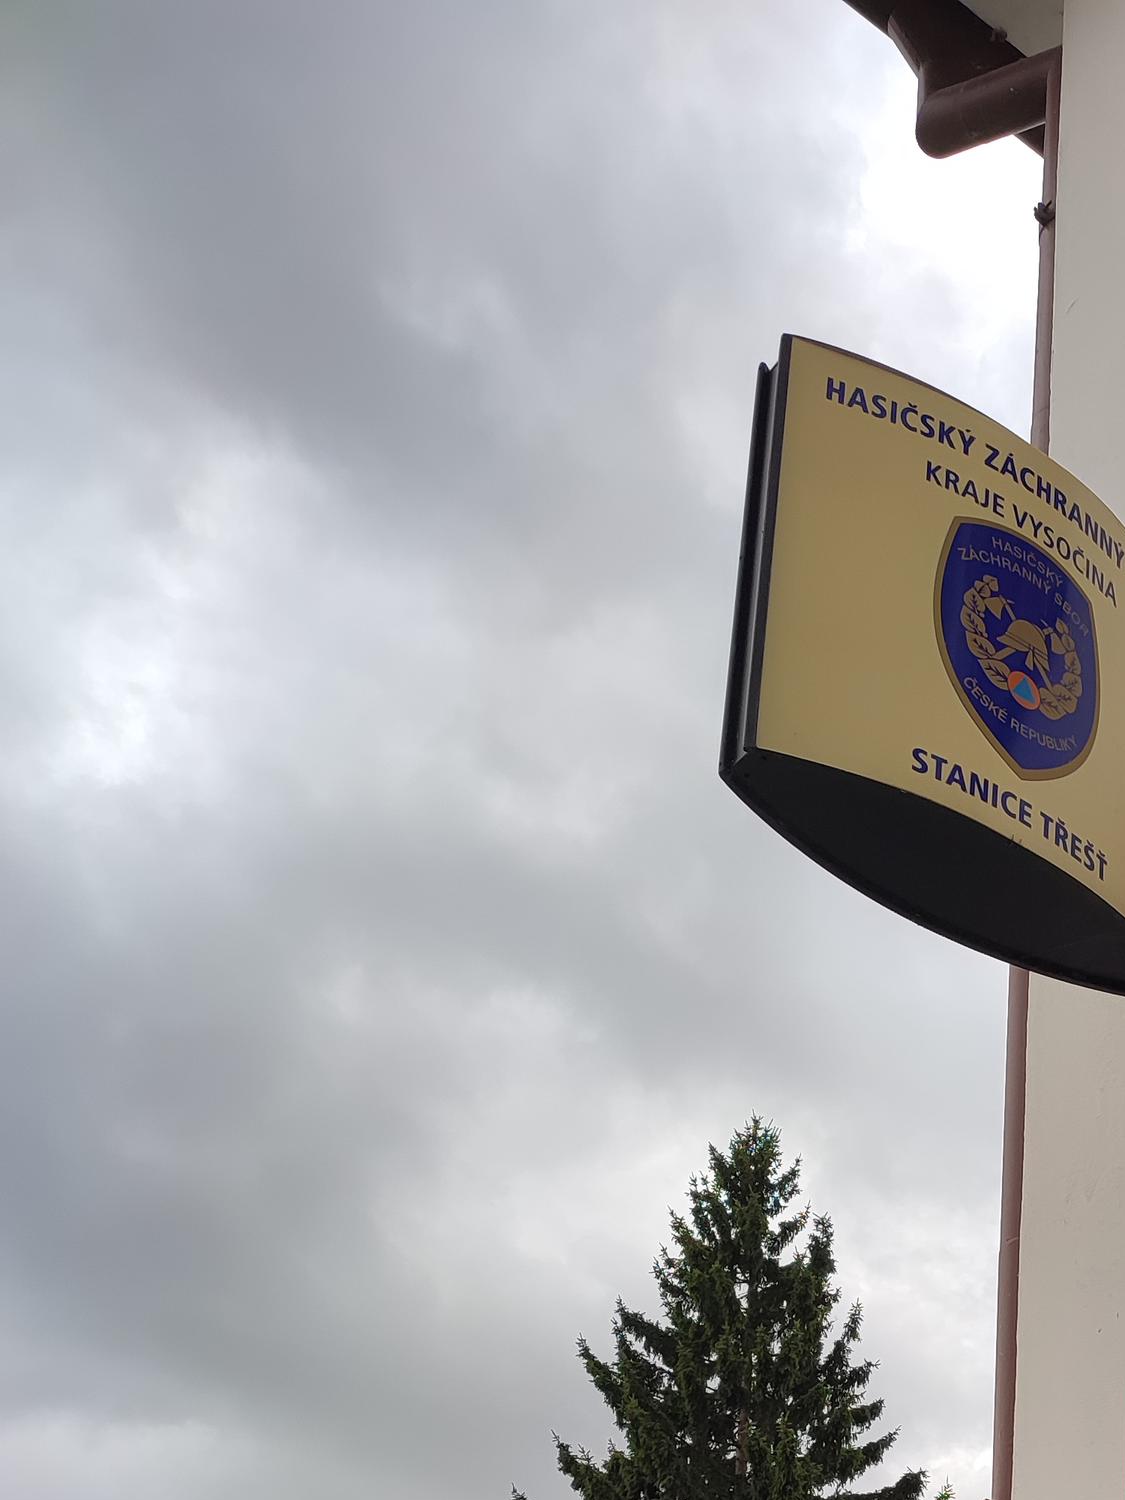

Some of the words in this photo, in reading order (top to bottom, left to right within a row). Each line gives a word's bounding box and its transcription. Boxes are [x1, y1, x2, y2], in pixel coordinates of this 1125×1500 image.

[825, 376, 976, 456] HASIČSKÝ
[984, 443, 1125, 569] ZÁCHRANNÝ
[925, 460, 1005, 518] KRAJE
[1012, 503, 1118, 608] VYSOČINA
[957, 544, 1051, 595] ZÁCHRANNÝ
[1054, 594, 1089, 637] SBOR
[991, 536, 1063, 587] HASIČSKÝ
[963, 675, 1007, 723] ČESKÉ
[1010, 717, 1077, 752] REPUBLIKY
[911, 747, 1032, 828] STANICE
[1040, 807, 1109, 882] TŘEŠŤ
